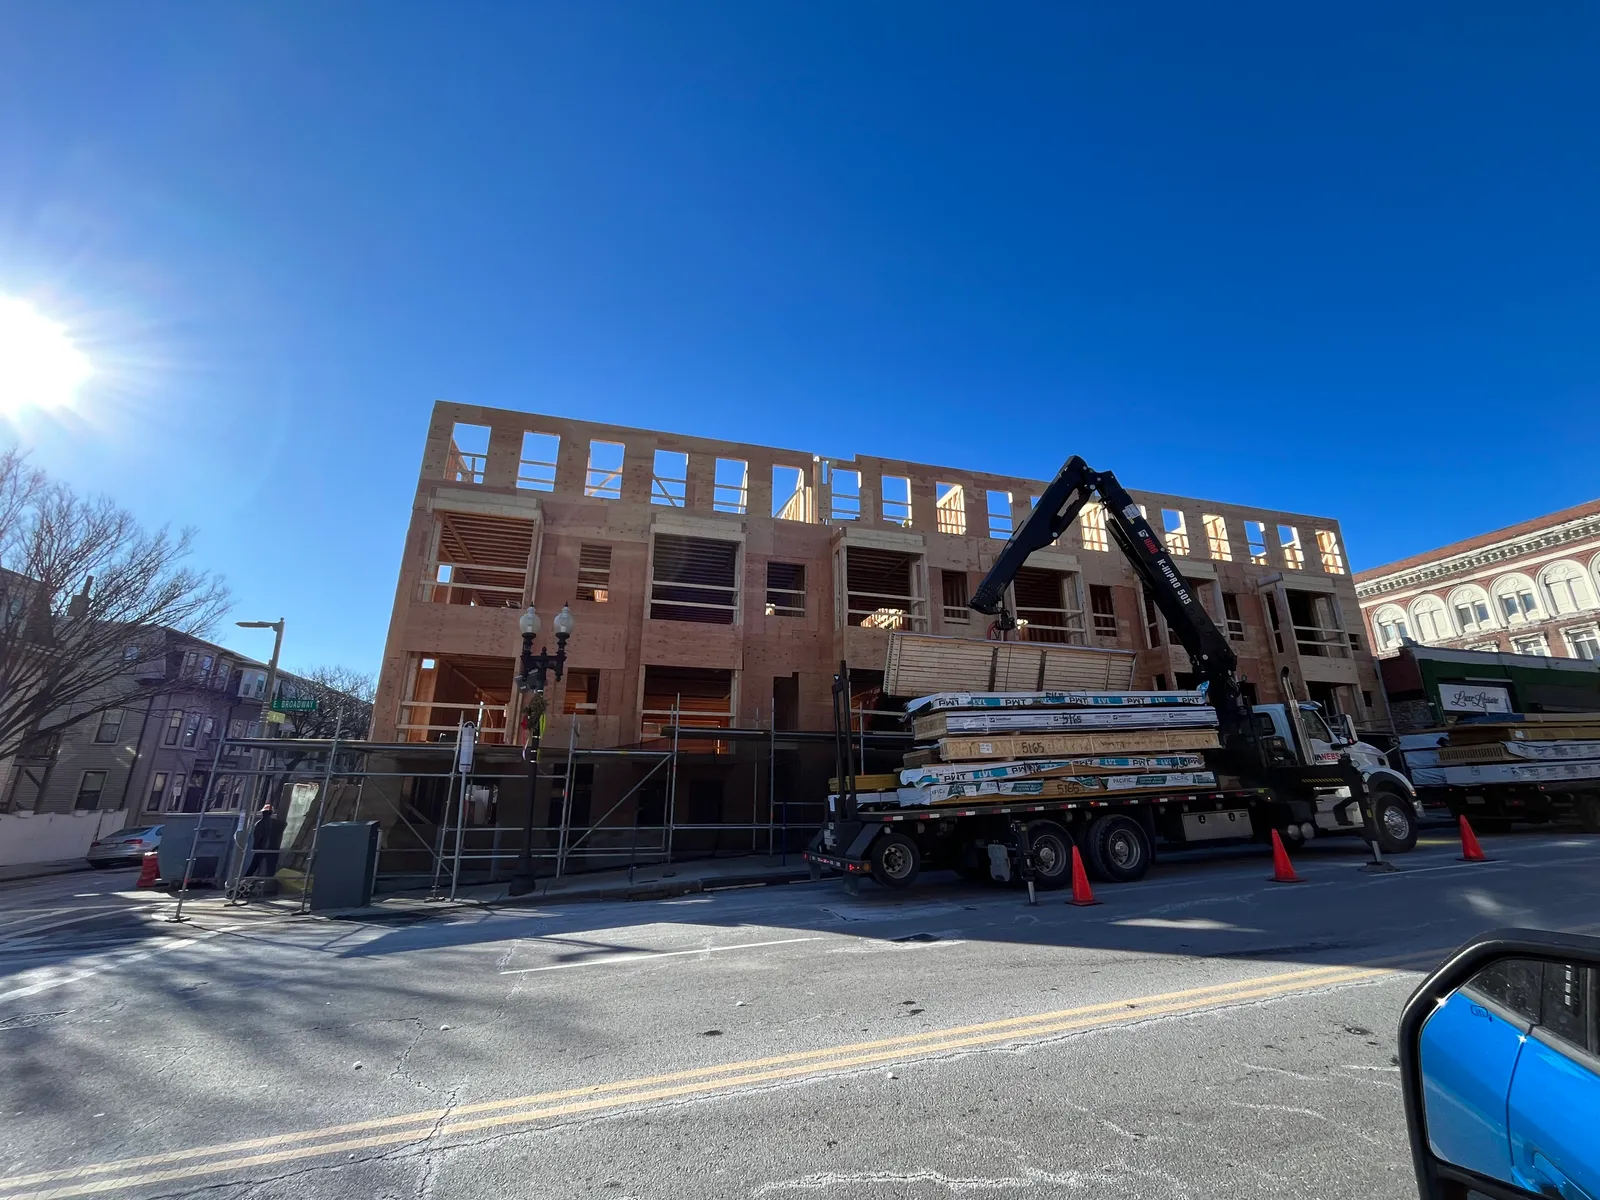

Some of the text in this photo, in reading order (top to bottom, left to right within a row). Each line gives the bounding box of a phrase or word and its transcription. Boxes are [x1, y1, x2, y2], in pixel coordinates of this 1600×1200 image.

[1156, 558, 1193, 605] K-HIPRO 505
[273, 700, 314, 708] E. BROADWAY
[1021, 742, 1045, 754] 5165
[944, 773, 966, 782] PWT
[1132, 758, 1151, 766] PWT
[1056, 783, 1080, 794] 5165
